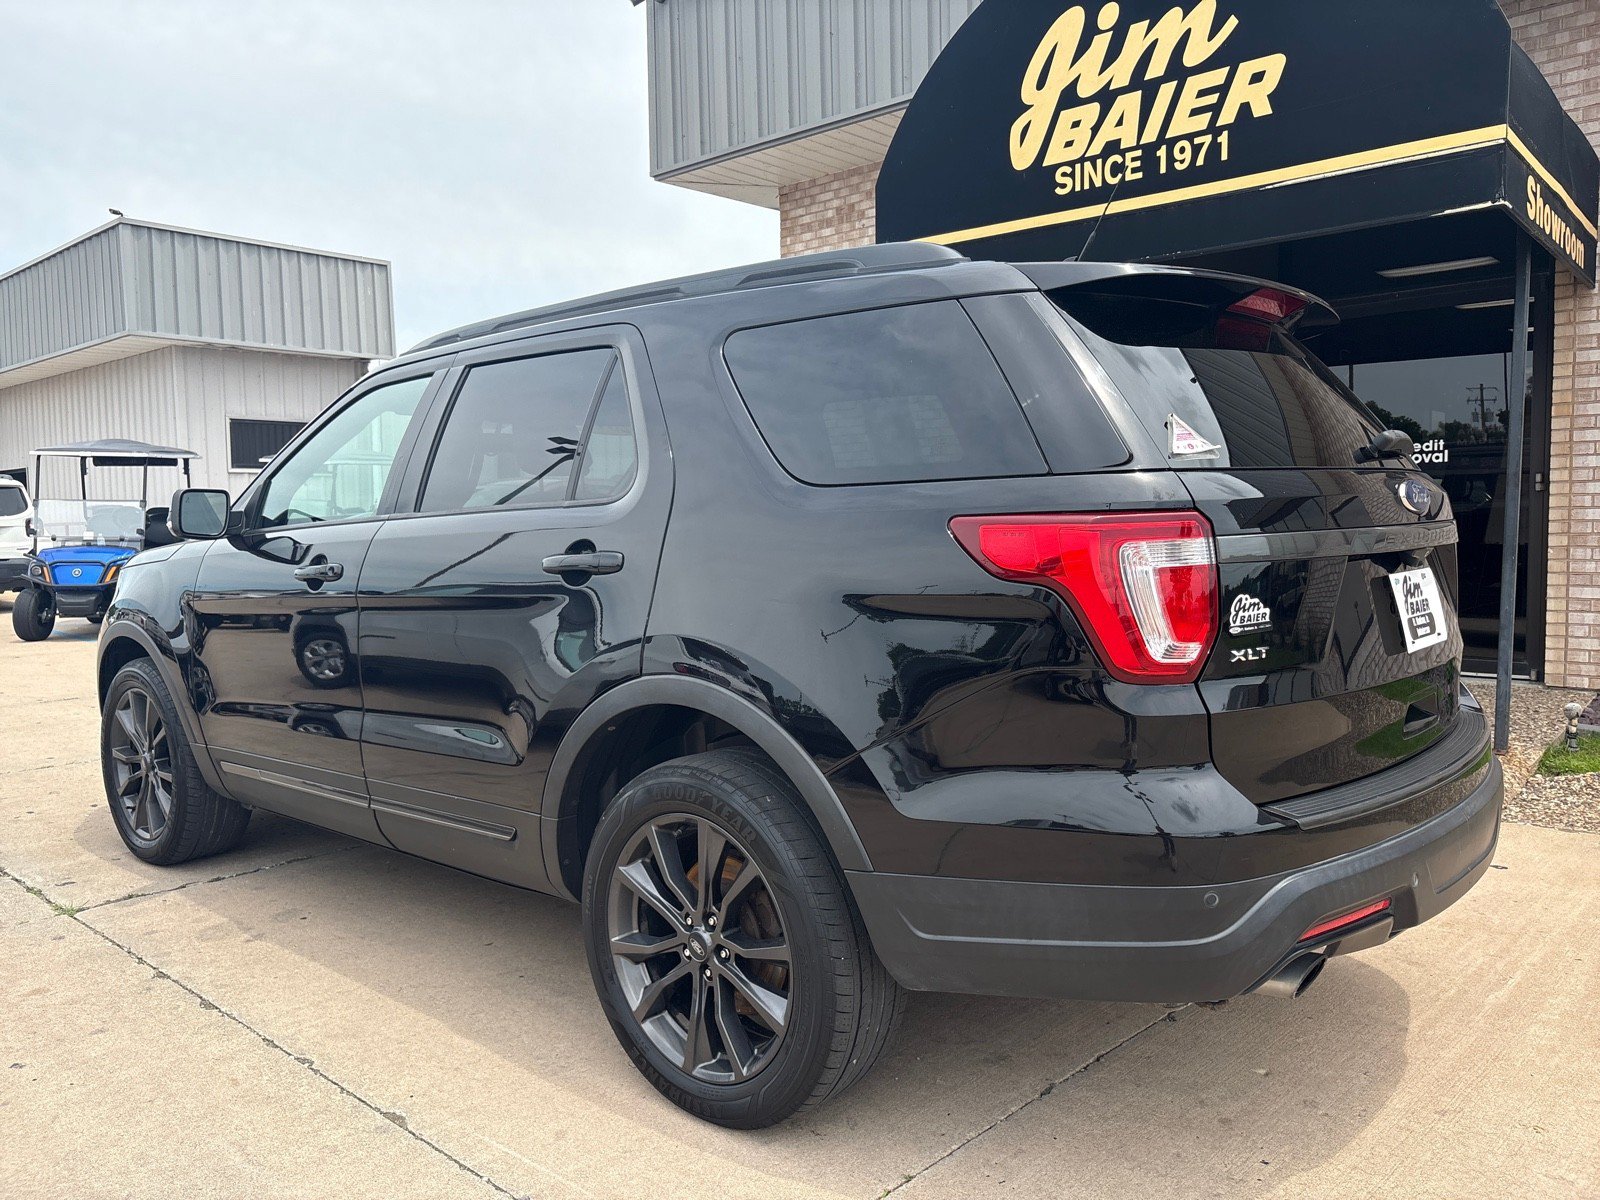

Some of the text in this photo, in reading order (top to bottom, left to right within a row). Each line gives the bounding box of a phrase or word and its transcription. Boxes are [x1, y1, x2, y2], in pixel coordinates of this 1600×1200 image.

[1009, 0, 1239, 171] Jim
[1042, 53, 1287, 167] BAIER
[1054, 130, 1230, 196] SINCE 1971
[1526, 174, 1585, 269] Showroom
[1409, 449, 1449, 464] oval
[1413, 439, 1445, 452] edit
[1402, 574, 1423, 615] Jim
[1410, 598, 1430, 615] BAIER
[1232, 596, 1261, 624] Jim
[1240, 612, 1267, 624] BAIER
[1230, 646, 1270, 663] XLT
